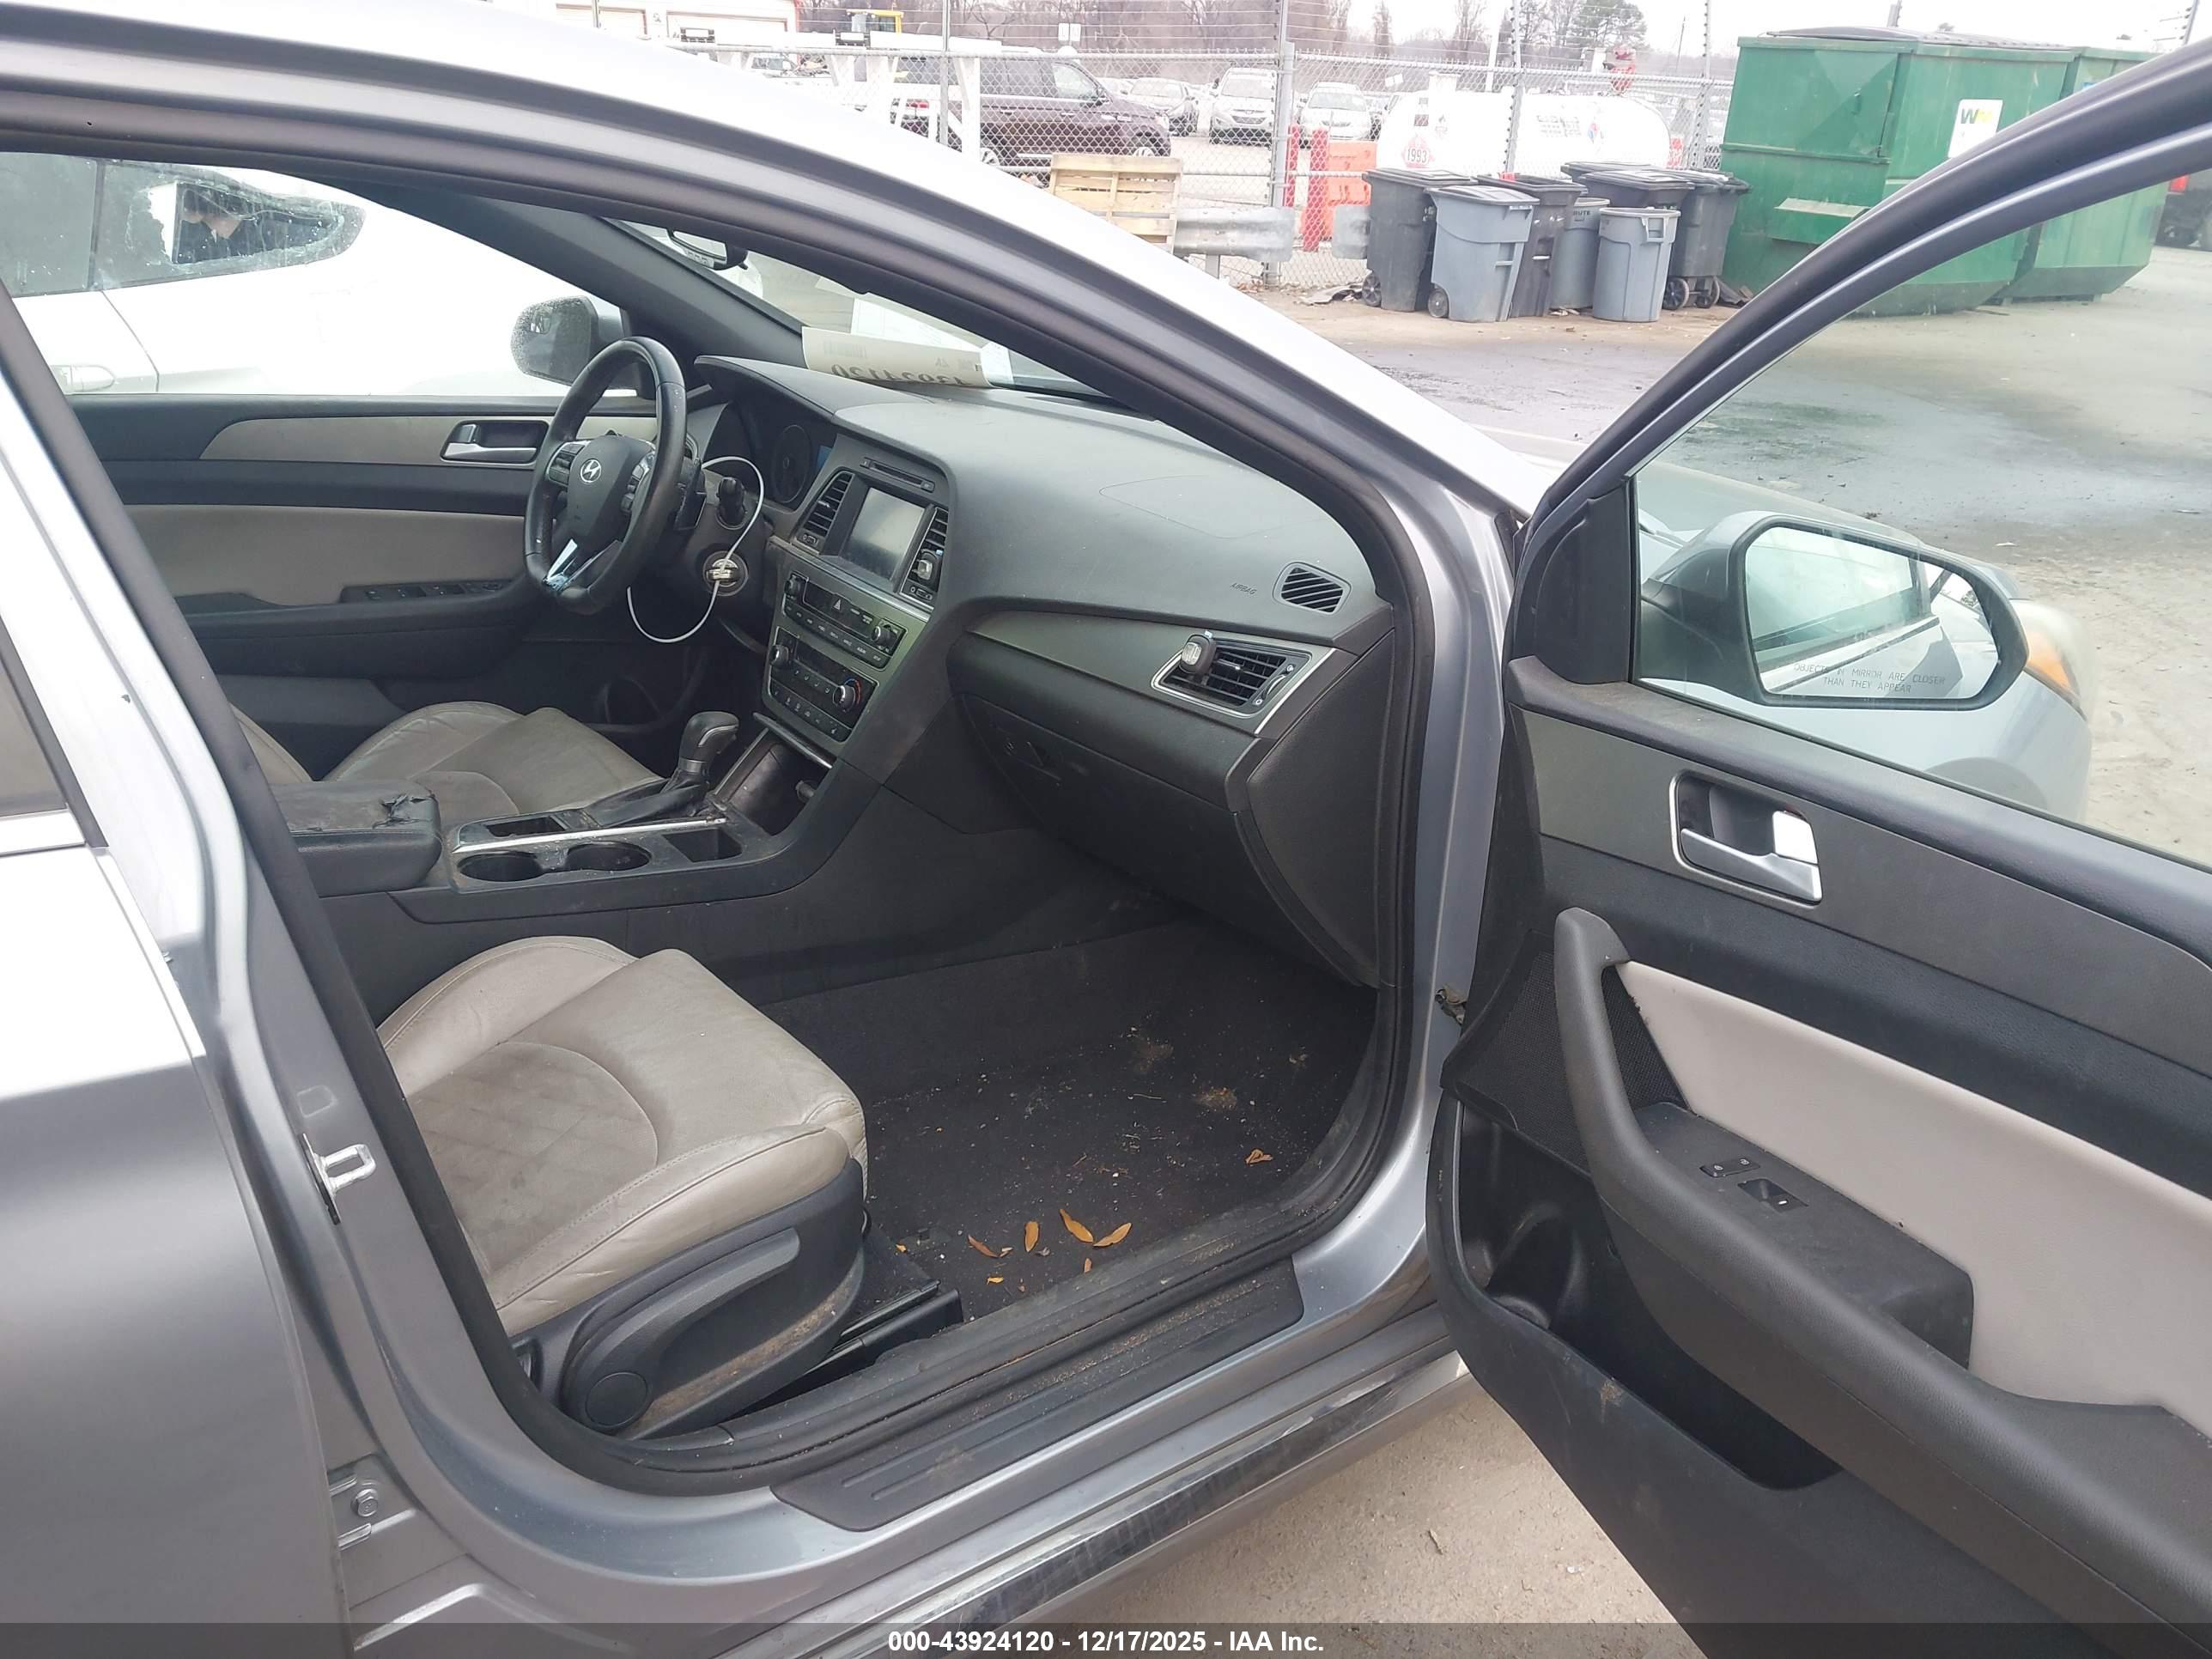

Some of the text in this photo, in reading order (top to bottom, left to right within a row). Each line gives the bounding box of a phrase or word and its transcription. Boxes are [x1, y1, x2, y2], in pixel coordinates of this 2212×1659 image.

[1407, 148, 1427, 163] 1993
[1231, 582, 1257, 595] AIRBAG
[1794, 663, 1830, 674] OBJECT
[1851, 668, 1882, 678] MIRROR
[1889, 672, 1905, 681] ARE
[1912, 674, 1946, 684] CLOSER
[1824, 677, 1911, 693] THAN THEY APPEAR
